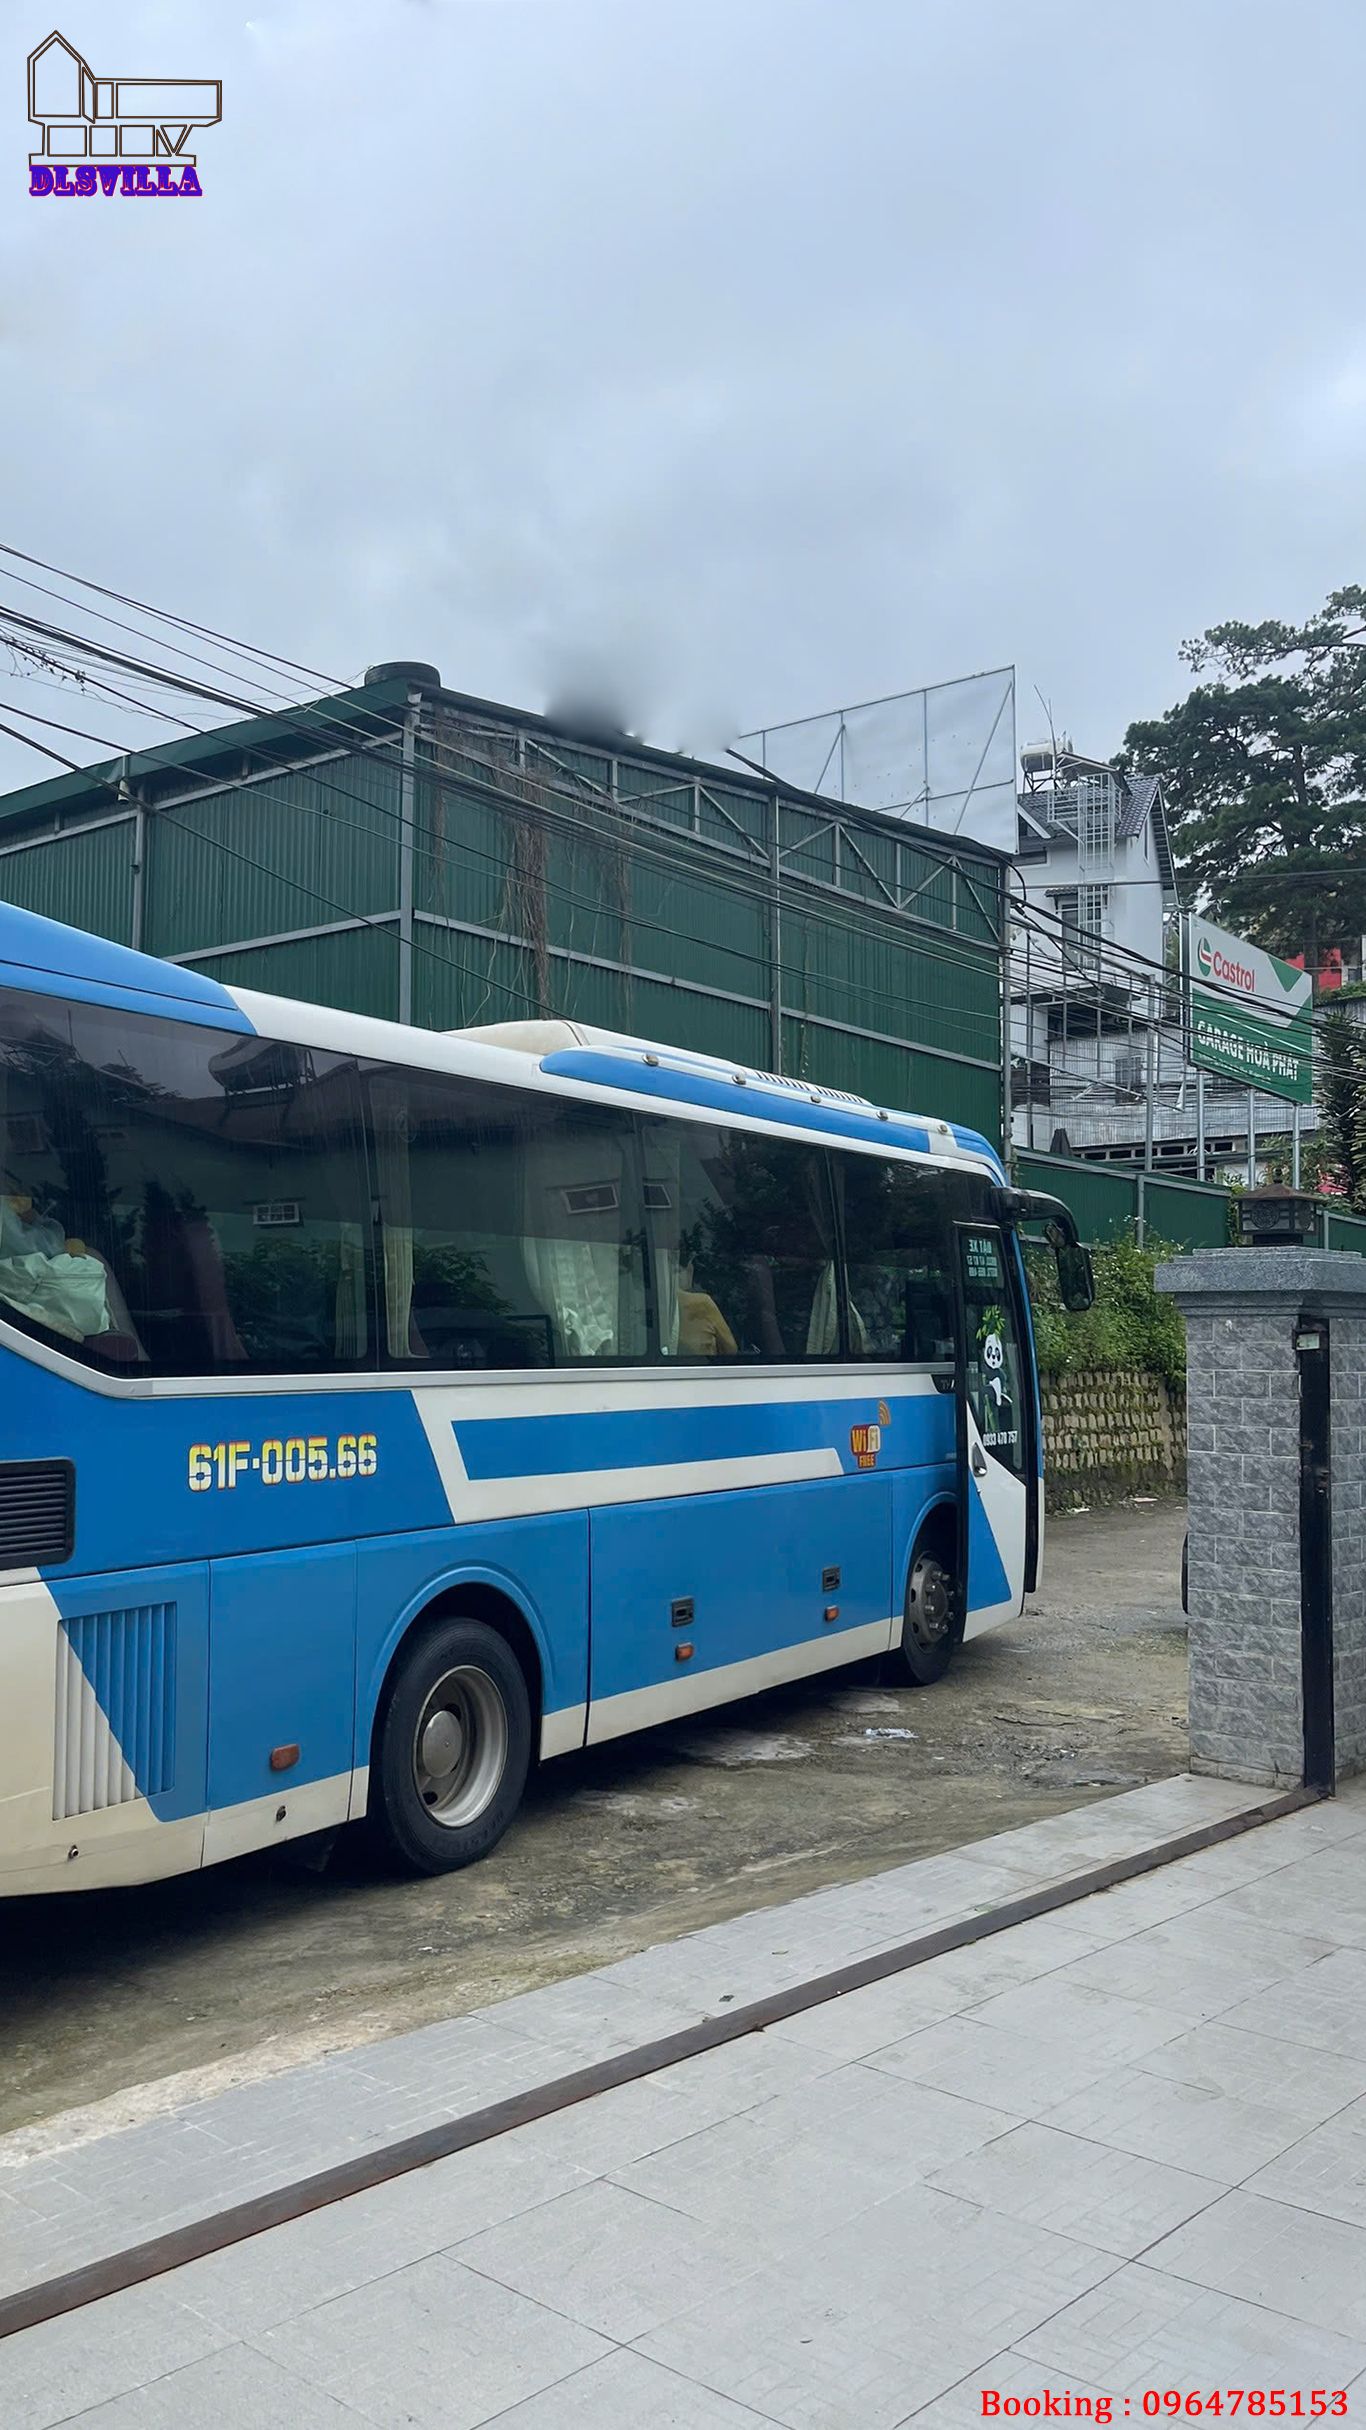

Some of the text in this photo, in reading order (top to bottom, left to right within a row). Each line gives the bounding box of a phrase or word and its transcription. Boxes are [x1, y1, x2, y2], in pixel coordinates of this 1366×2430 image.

[1213, 951, 1255, 993] Castrol
[1197, 1020, 1244, 1060] GARAGE
[188, 1432, 378, 1492] 61F-005.66
[859, 1454, 875, 1468] FREE
